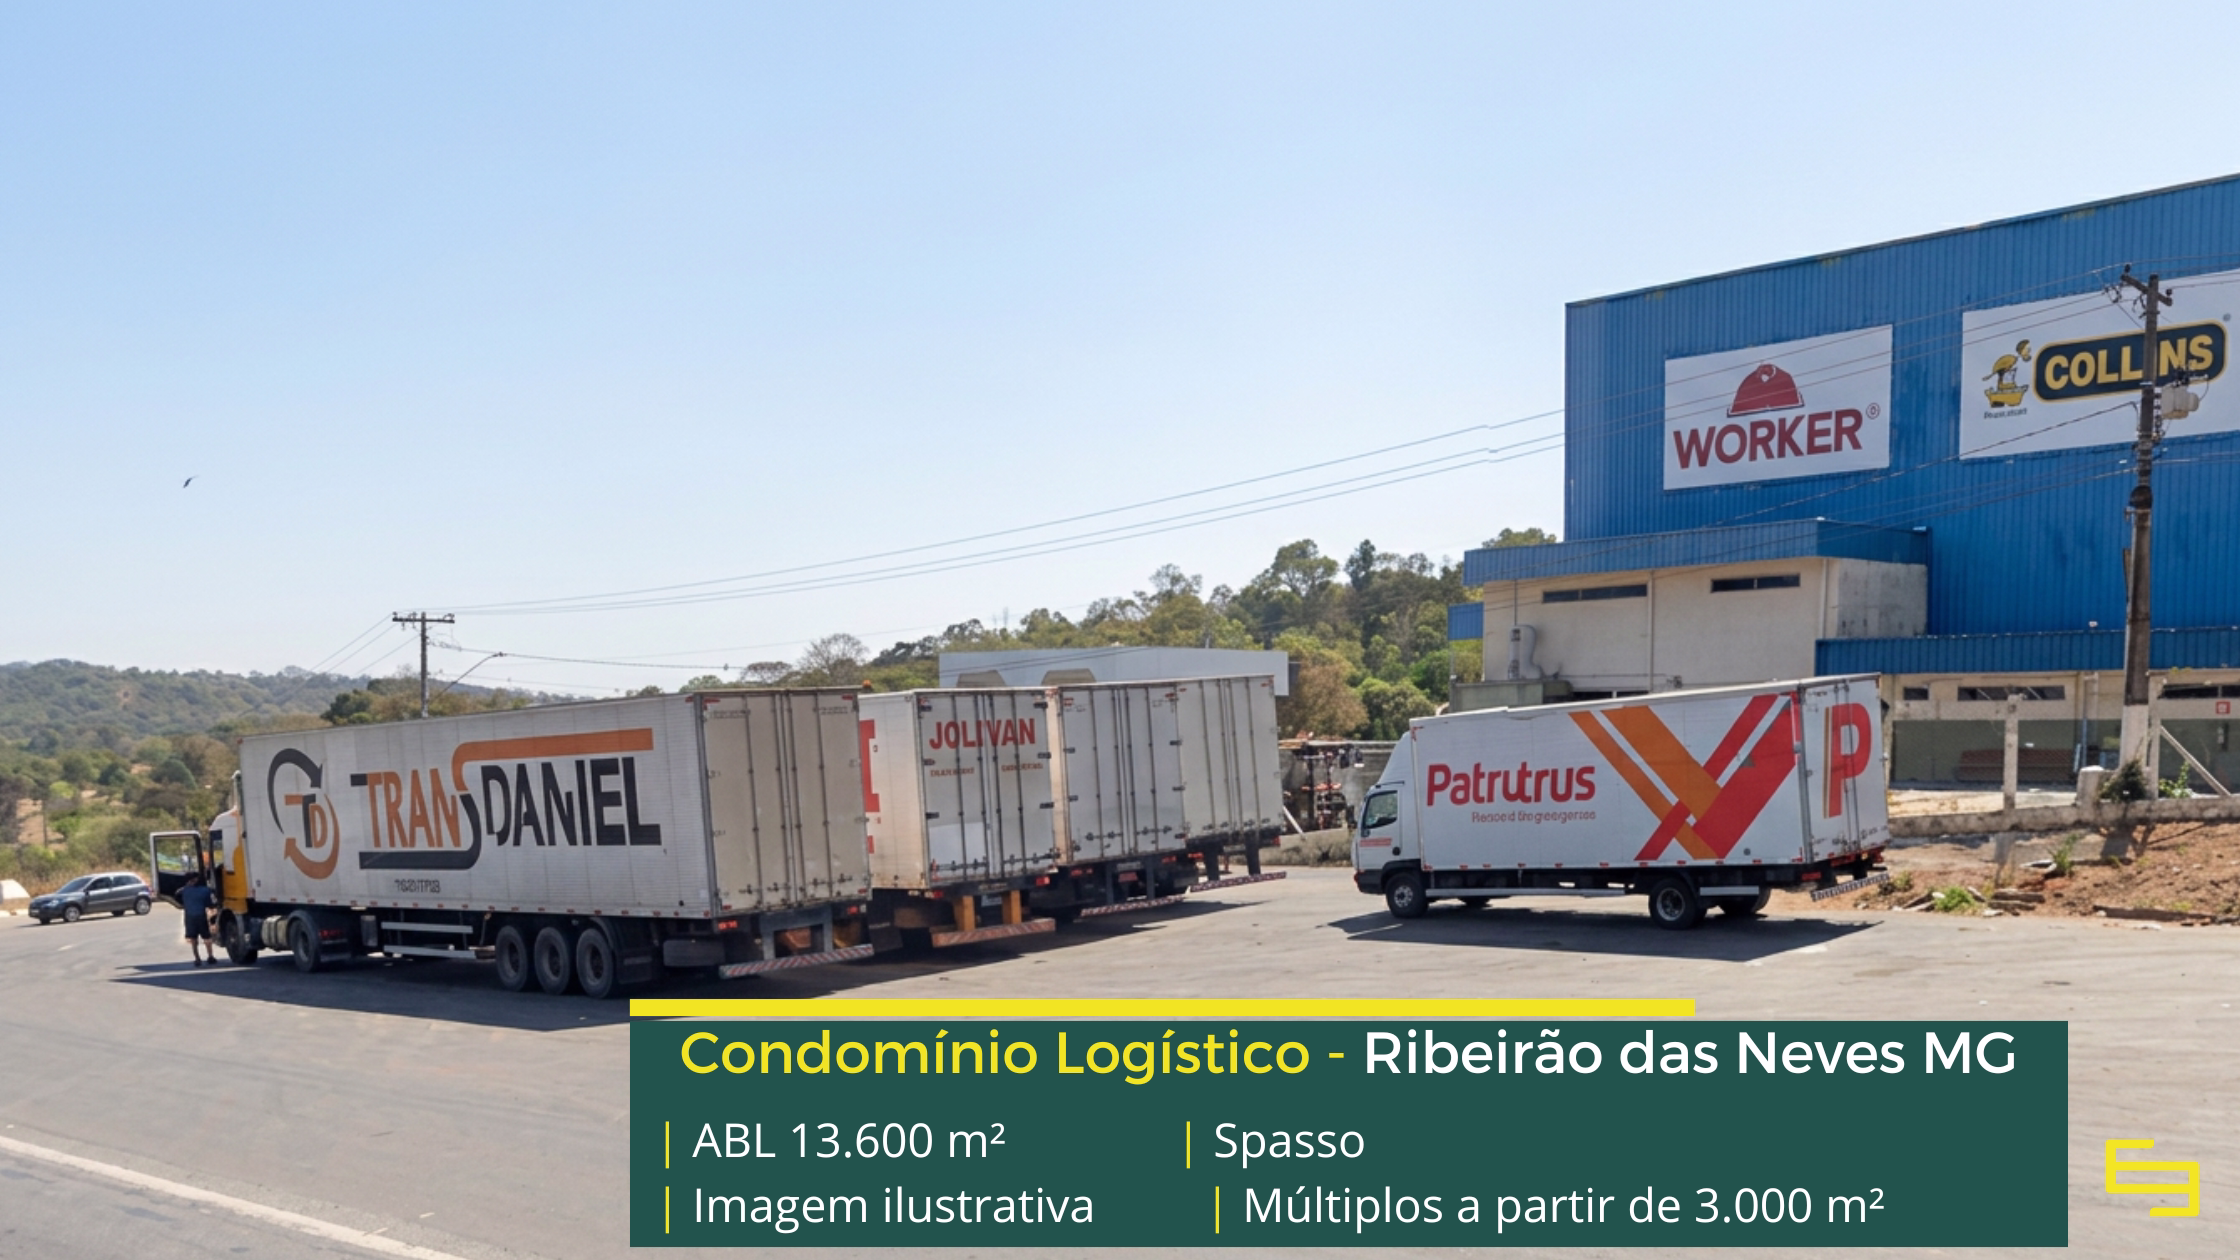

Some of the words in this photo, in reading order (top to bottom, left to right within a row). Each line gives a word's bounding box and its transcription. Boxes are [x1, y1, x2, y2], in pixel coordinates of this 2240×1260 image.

[2045, 335, 2213, 390] COLLNS
[1673, 408, 1863, 469] WORKER
[929, 718, 1036, 750] JOLIVAN
[1427, 761, 1596, 806] Patrutrus
